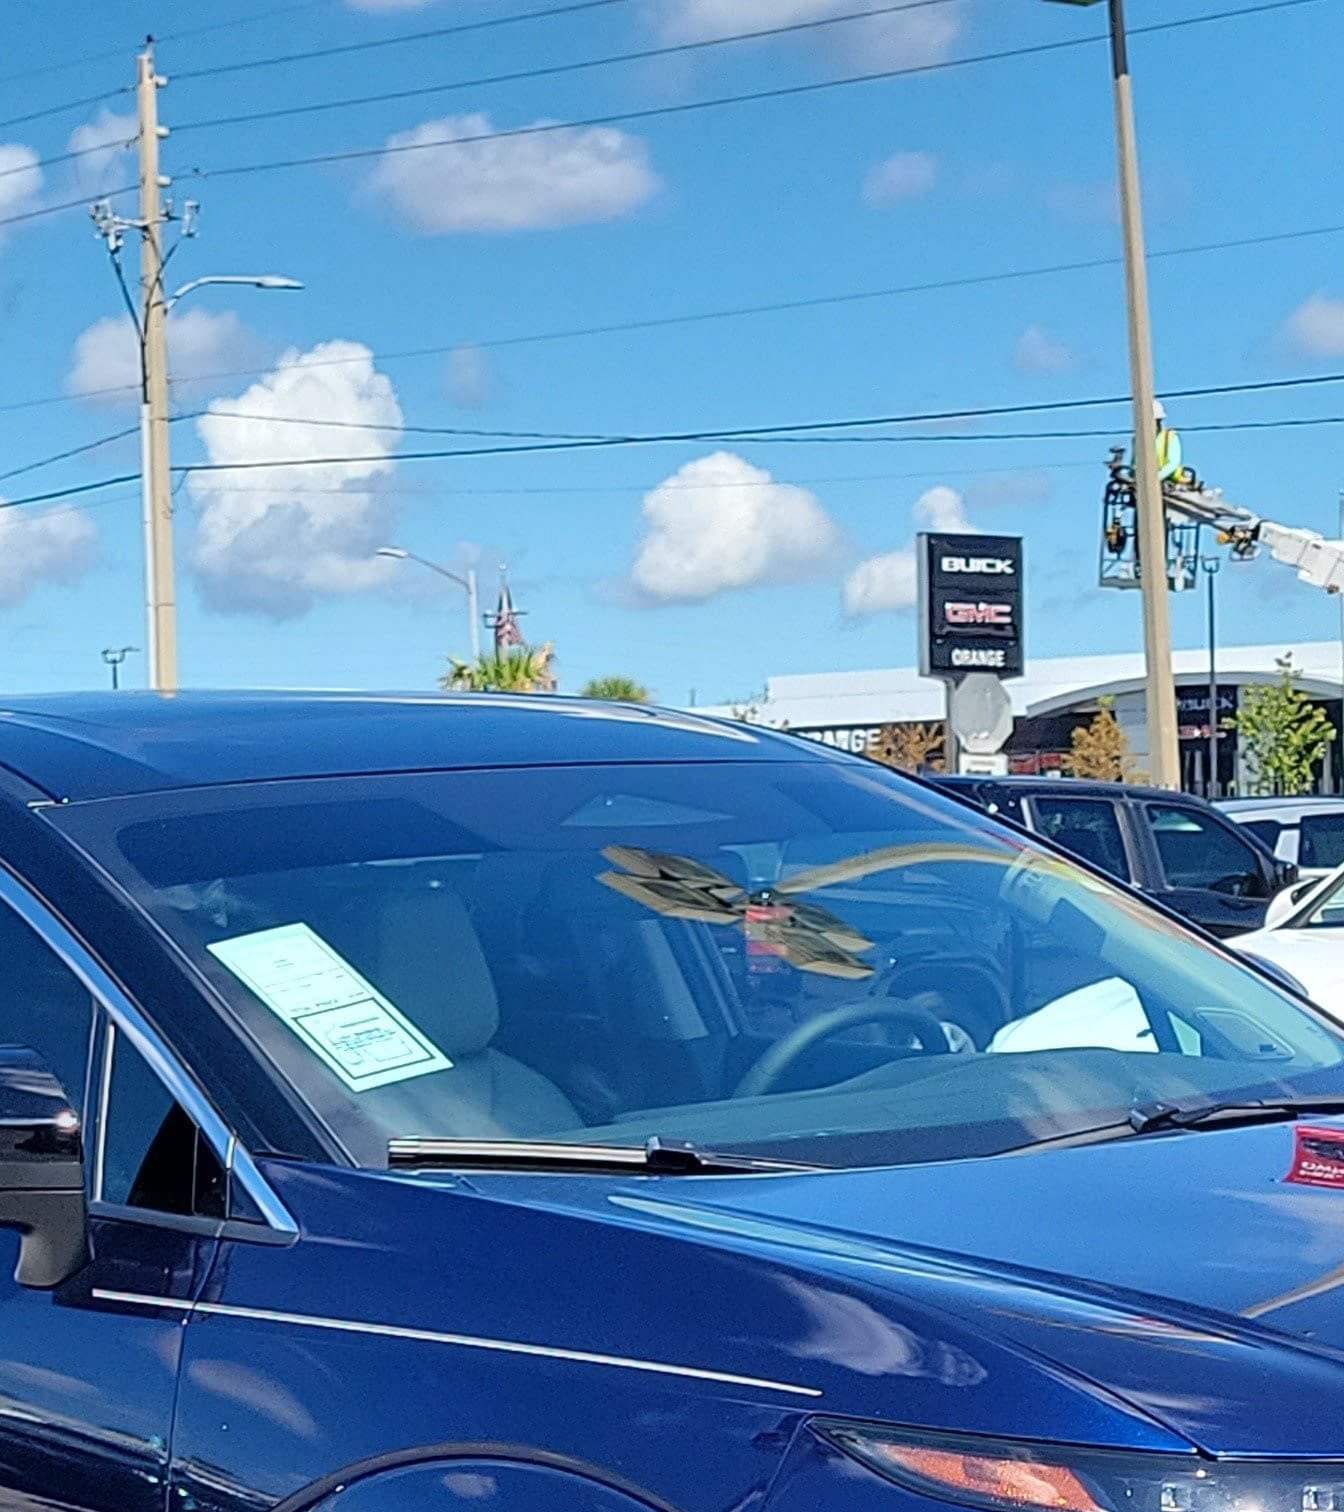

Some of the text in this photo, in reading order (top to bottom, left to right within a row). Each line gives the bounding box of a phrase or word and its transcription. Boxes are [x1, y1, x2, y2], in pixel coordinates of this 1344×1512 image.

[941, 556, 1015, 574] BUICK
[944, 602, 1012, 624] GMC
[951, 648, 1006, 667] ORANGE
